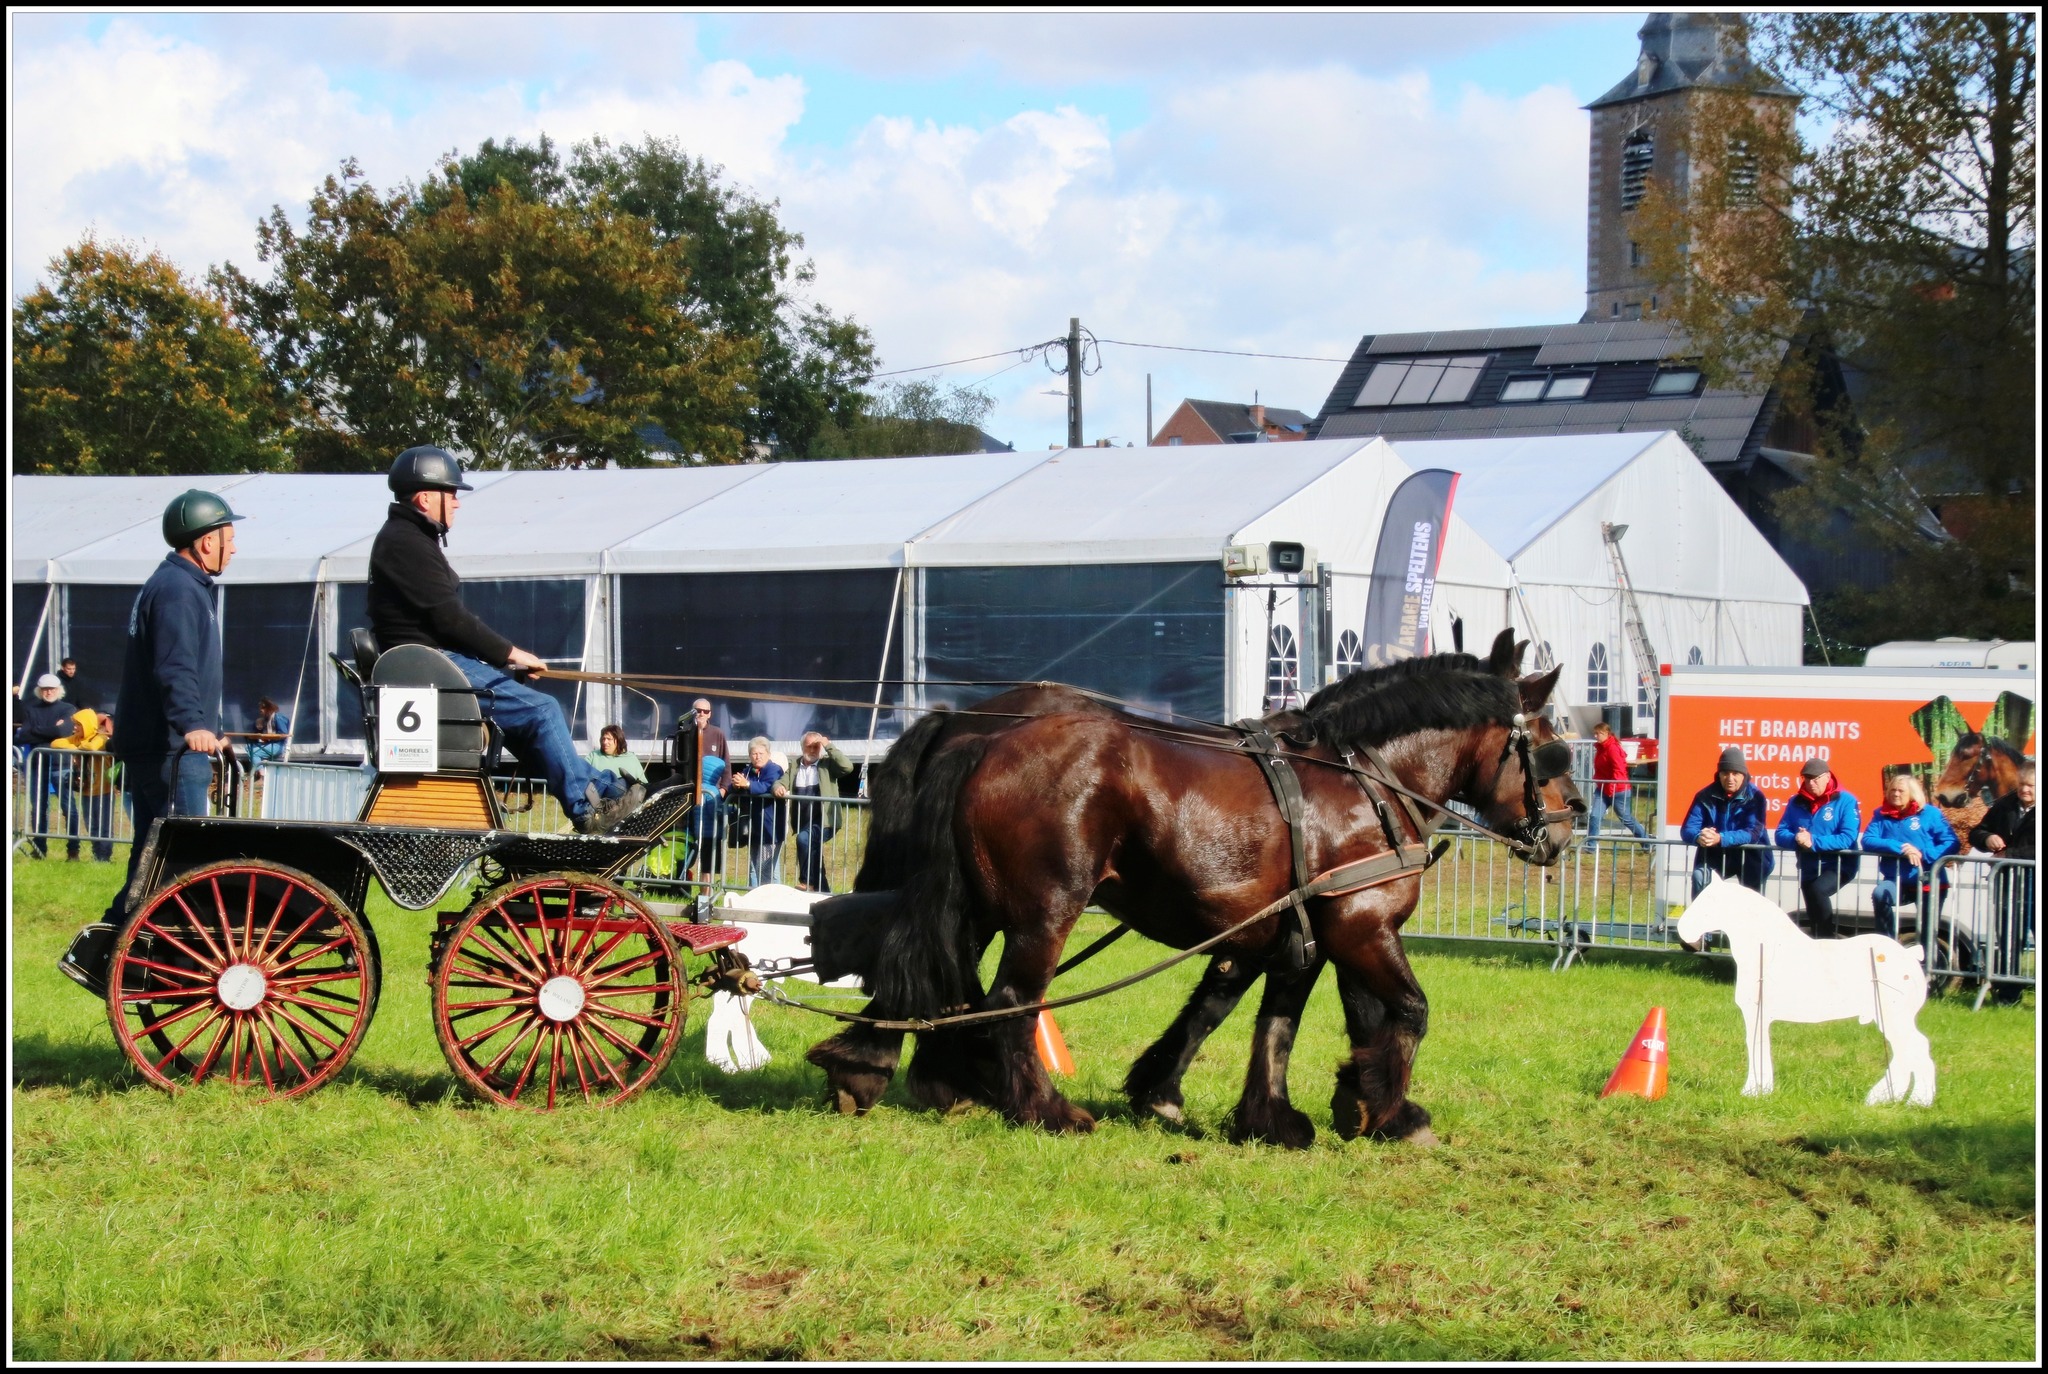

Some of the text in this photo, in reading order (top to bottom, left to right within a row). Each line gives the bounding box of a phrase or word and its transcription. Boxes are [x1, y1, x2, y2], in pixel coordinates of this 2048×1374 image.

[1405, 522, 1432, 593] SPELTENS
[1418, 578, 1434, 629] VOLLEZELE
[396, 700, 422, 733] 6
[1719, 719, 1860, 739] HET BRABANTS
[1718, 743, 1830, 762] TEKPAARD
[1751, 773, 1790, 789] rots
[1641, 1039, 1665, 1052] START
